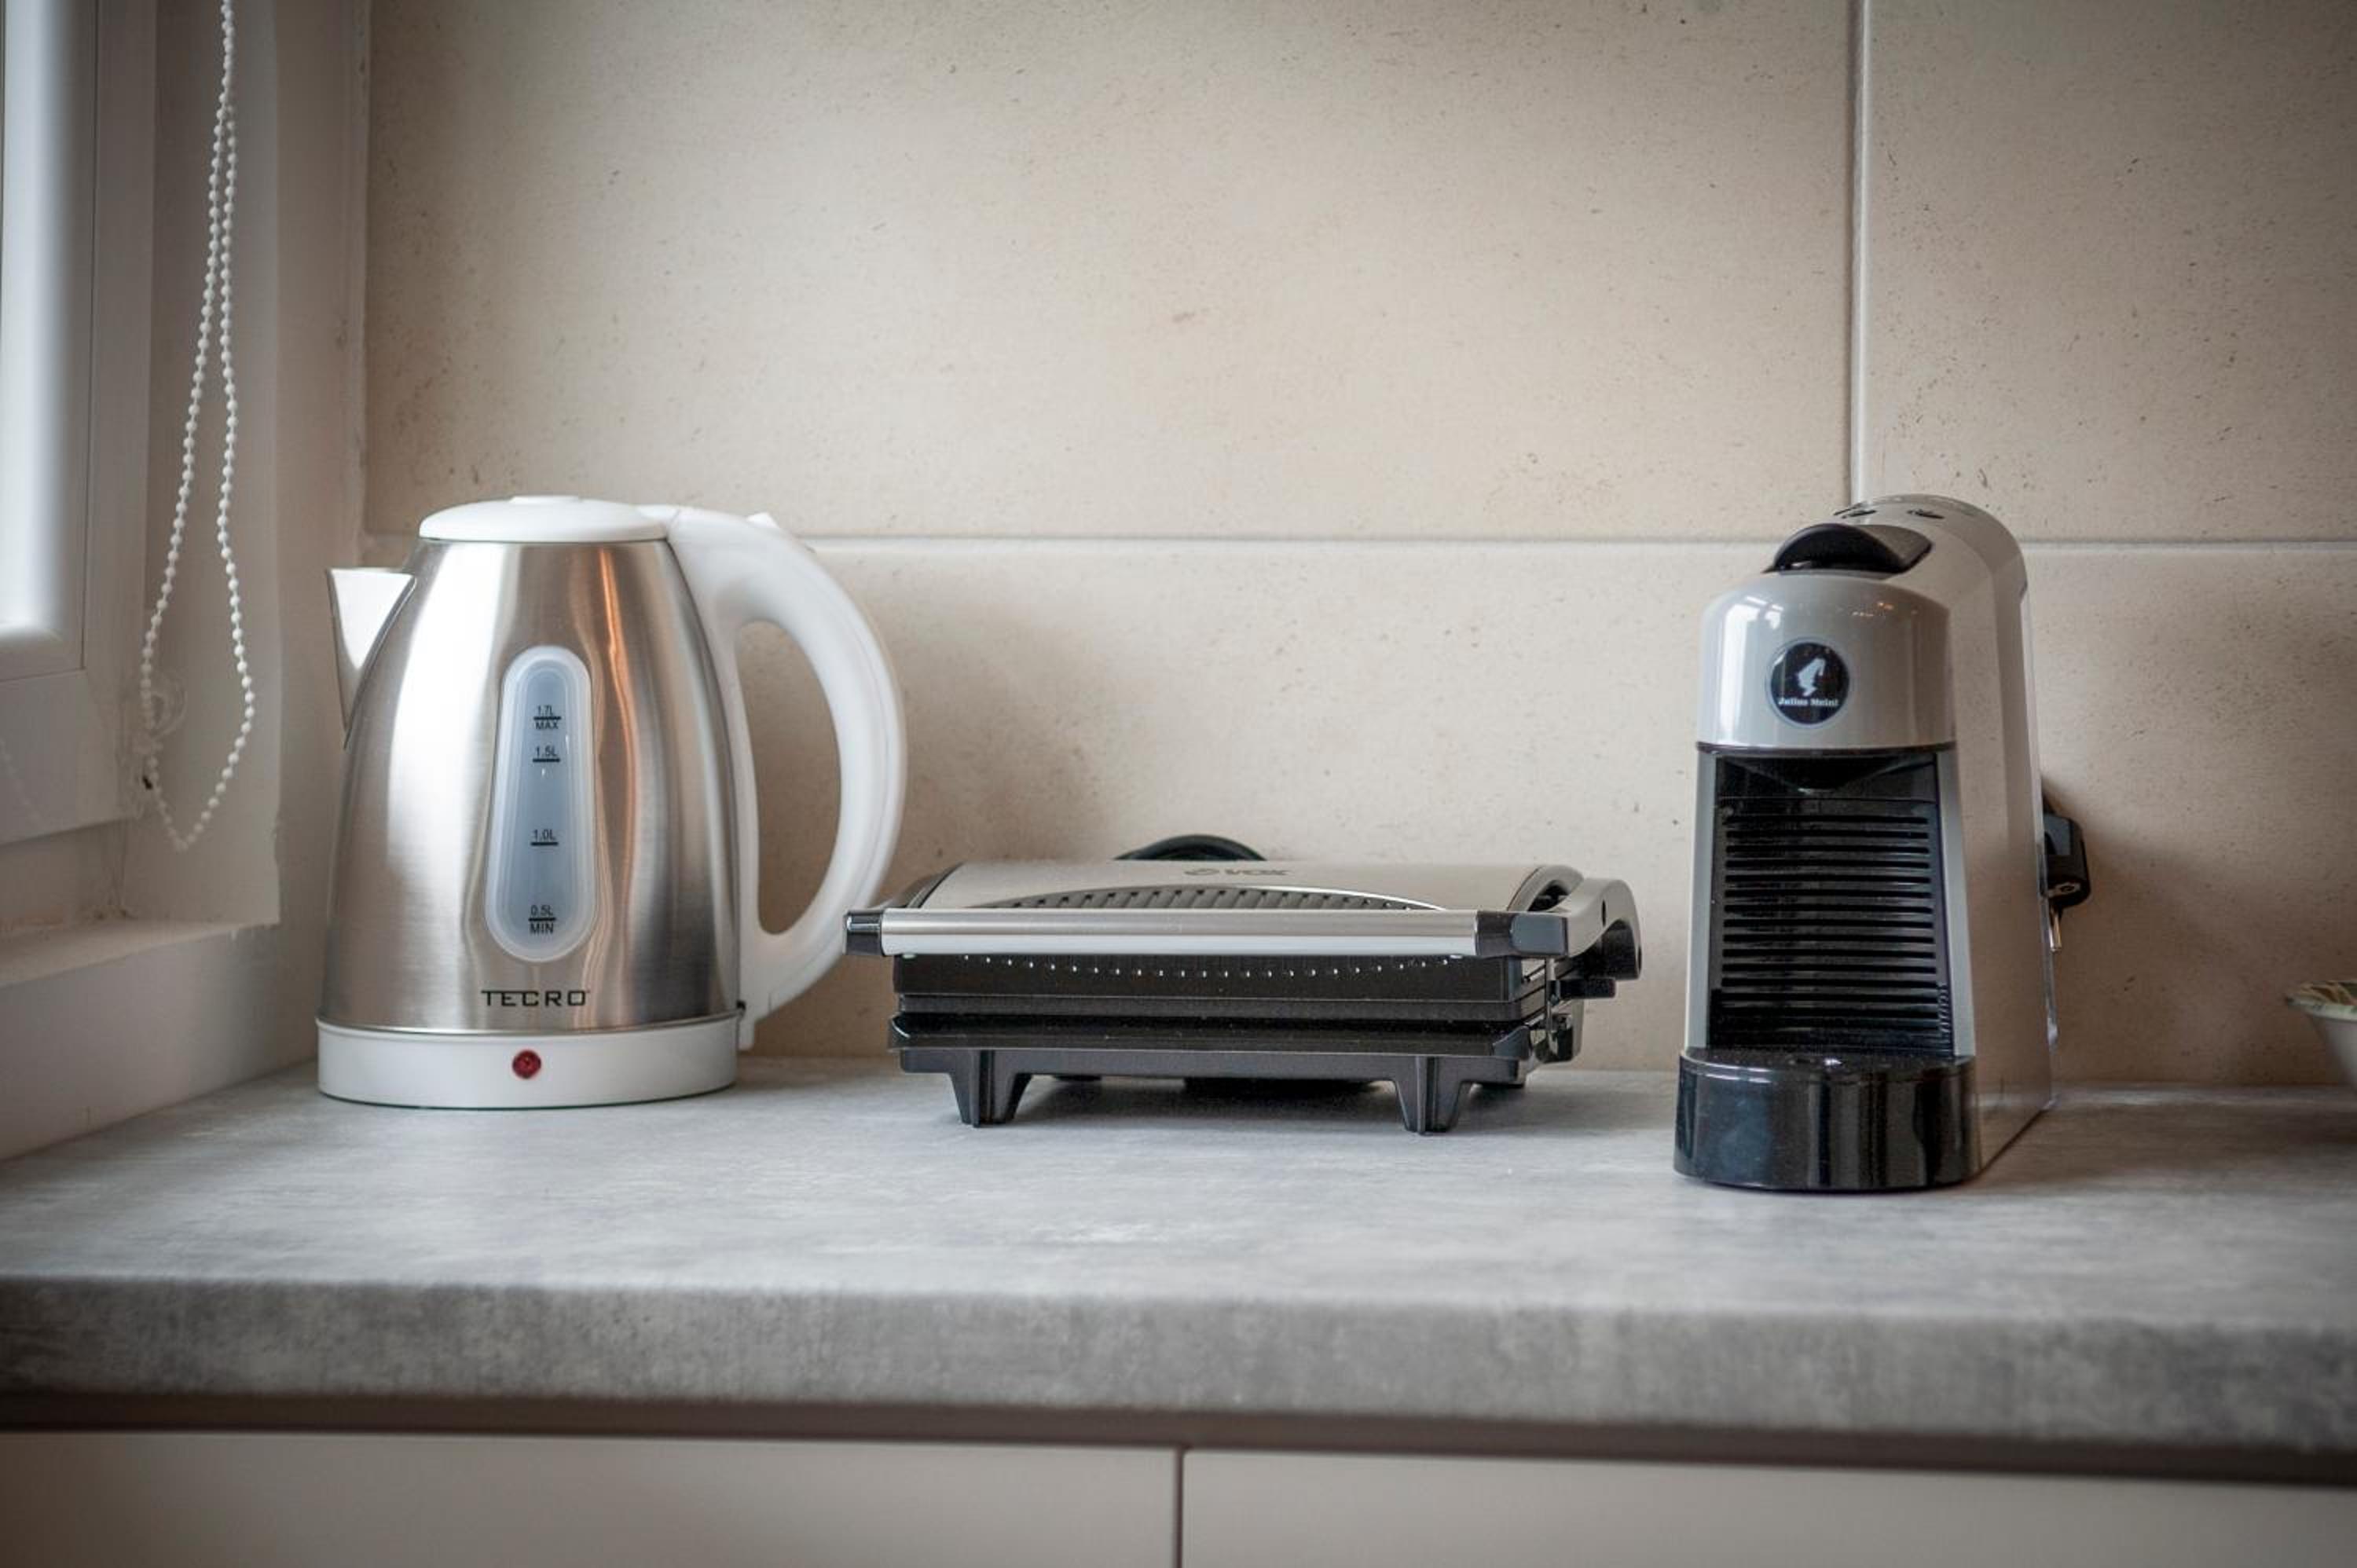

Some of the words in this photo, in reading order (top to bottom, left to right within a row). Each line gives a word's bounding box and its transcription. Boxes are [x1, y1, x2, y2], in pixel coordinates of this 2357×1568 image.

[535, 720, 559, 730] MAX
[536, 746, 558, 757] 1.5L
[533, 829, 556, 841] 1.0L
[530, 904, 554, 917] 0.5L
[530, 921, 554, 935] MIN
[481, 990, 588, 1007] TECRO
